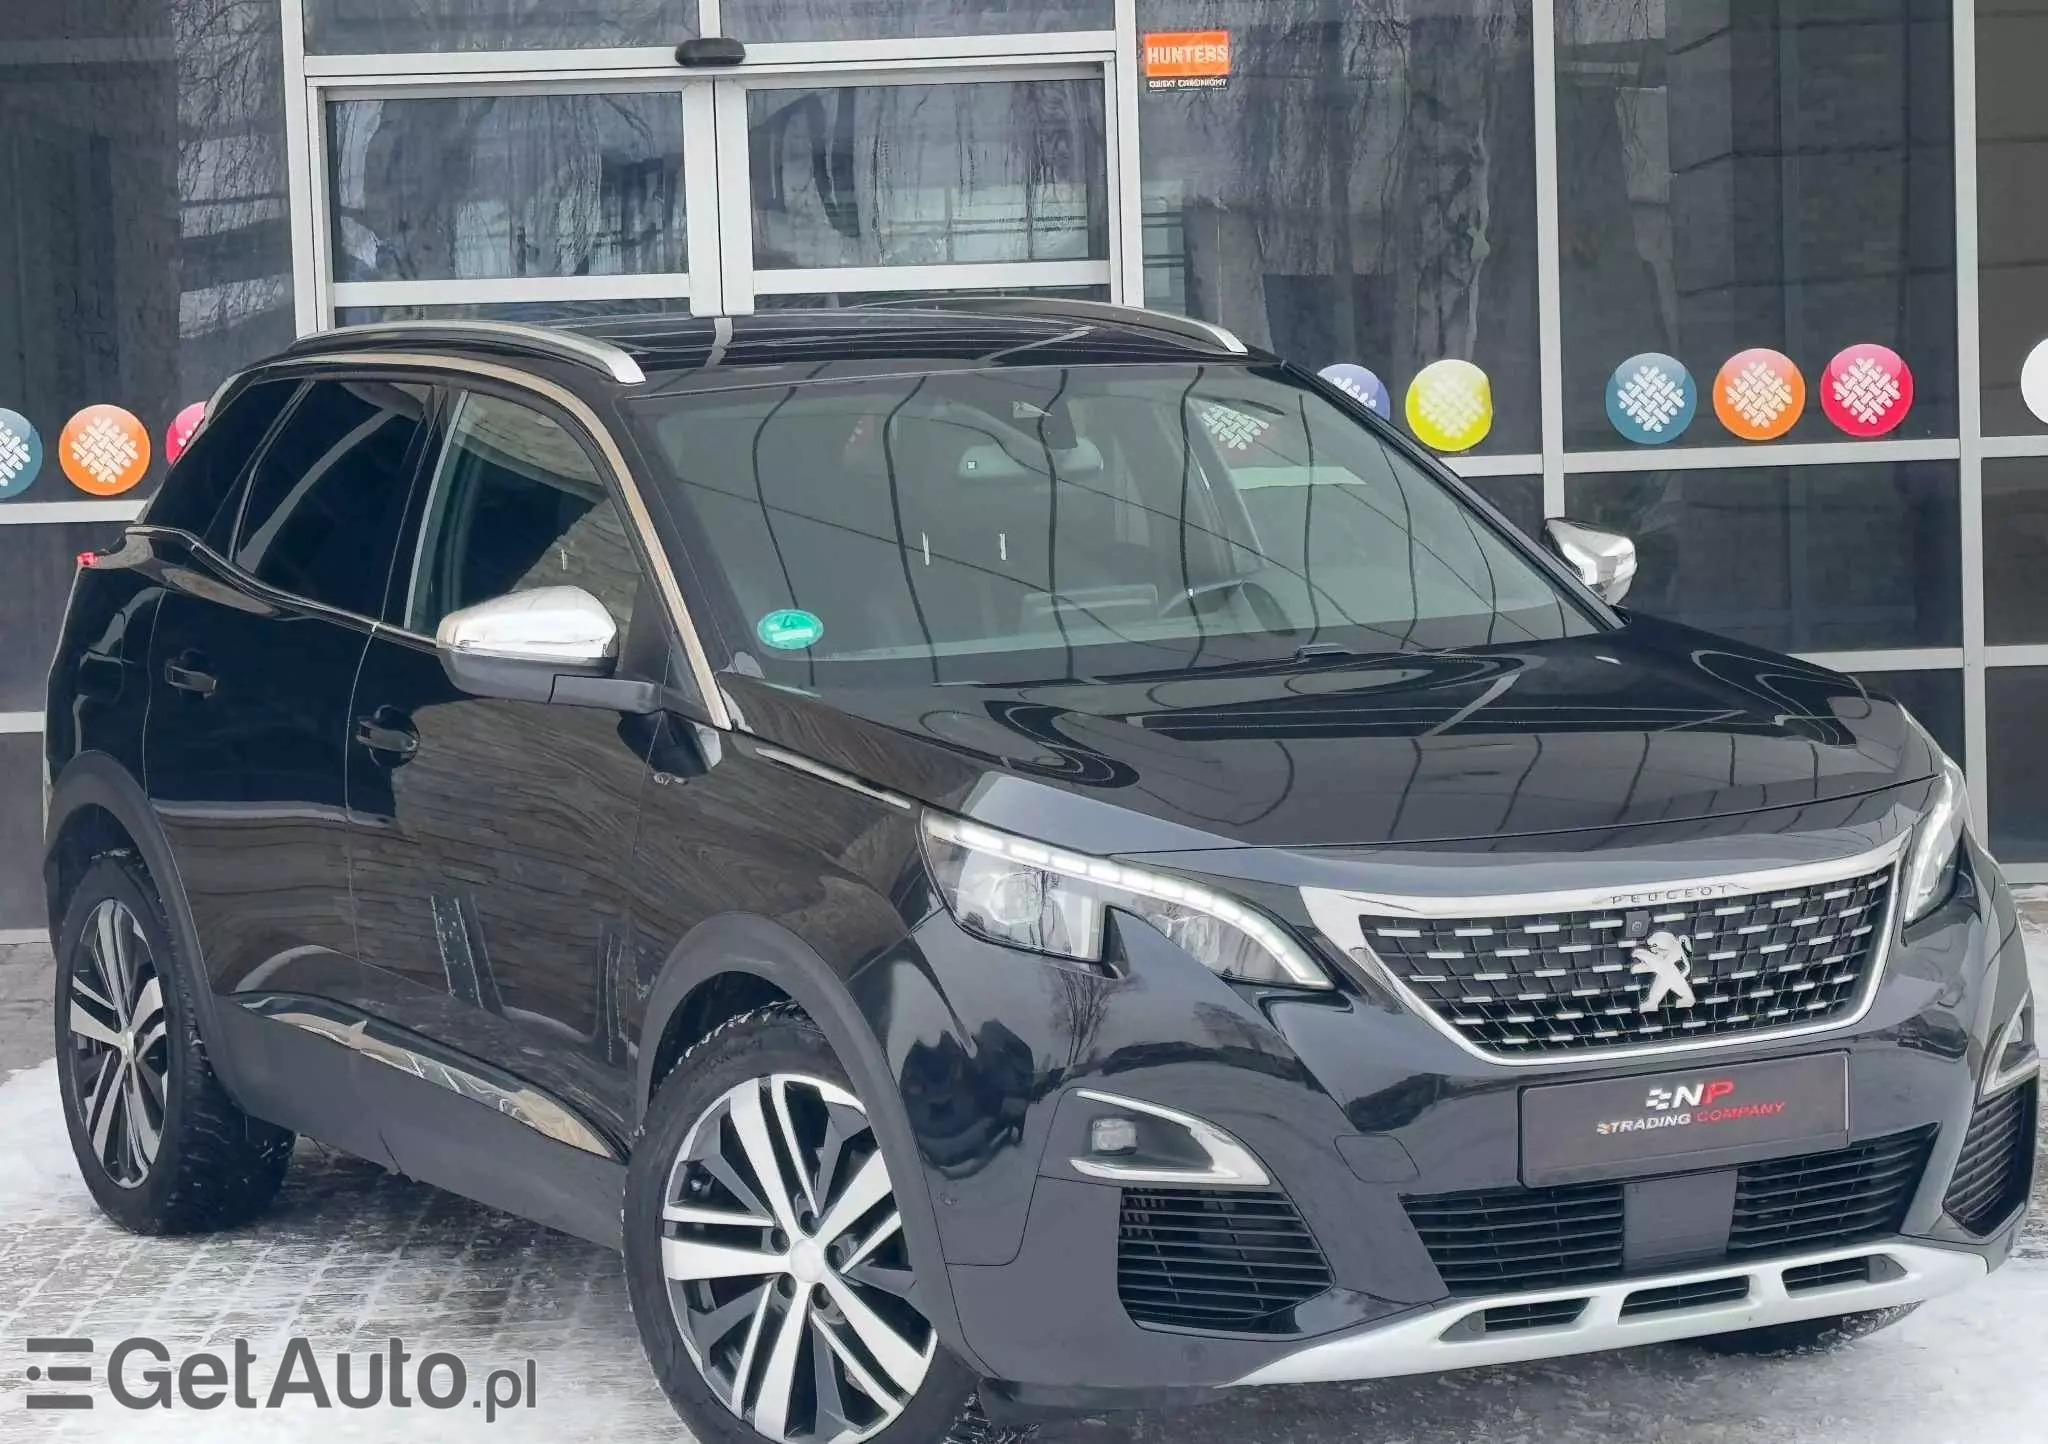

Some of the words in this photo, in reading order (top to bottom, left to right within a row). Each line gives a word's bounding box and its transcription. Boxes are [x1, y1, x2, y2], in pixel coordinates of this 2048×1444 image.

[1147, 44, 1228, 65] HUNTERS
[1610, 885, 1729, 905] PEUGEOT
[1671, 1081, 1734, 1109] NP
[1695, 1100, 1786, 1122] COMPANY
